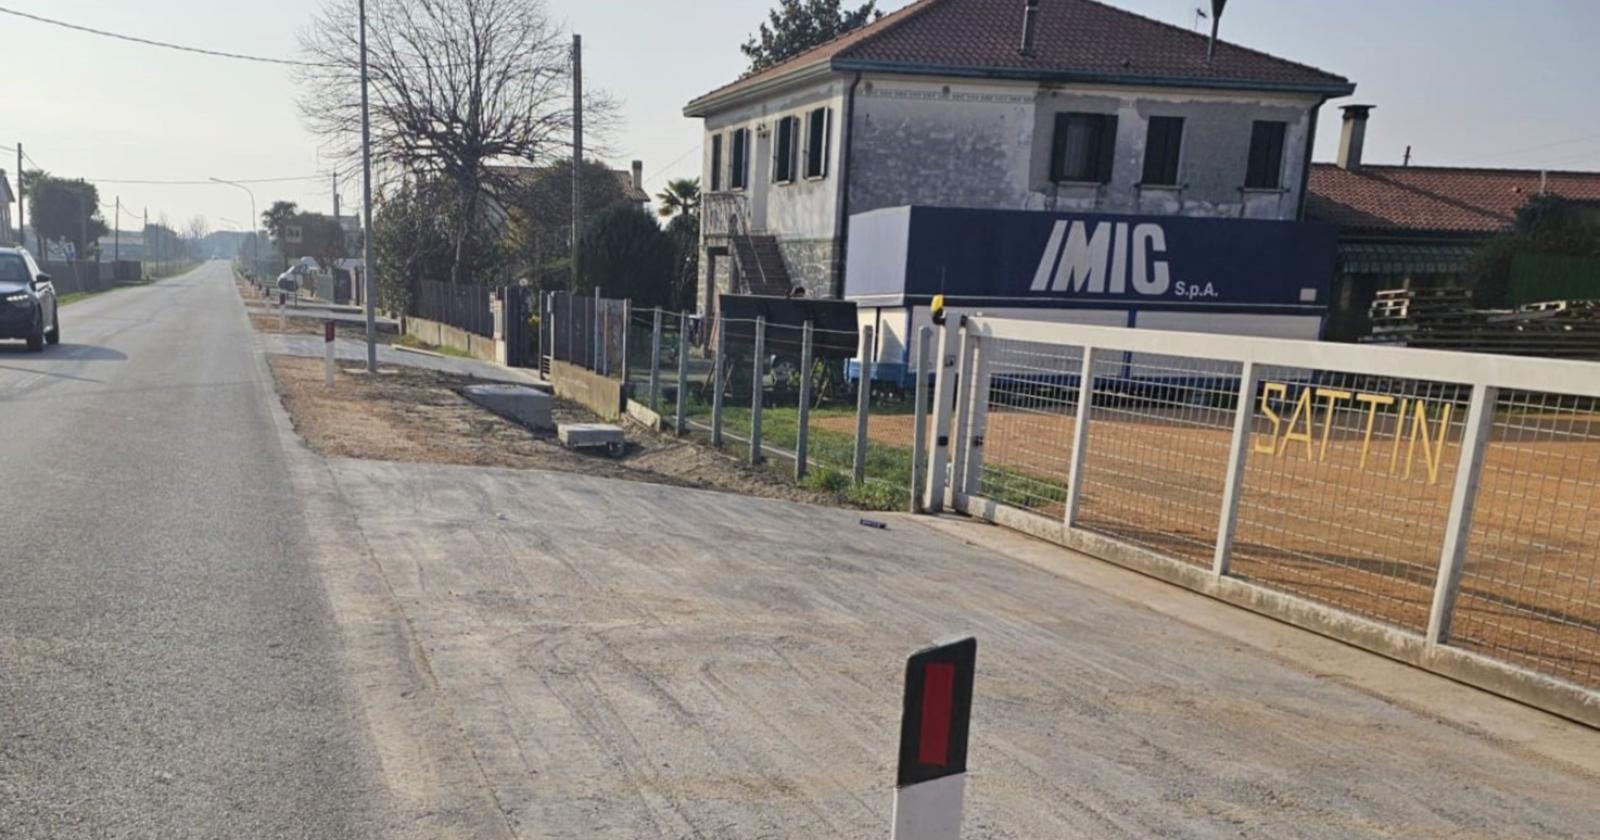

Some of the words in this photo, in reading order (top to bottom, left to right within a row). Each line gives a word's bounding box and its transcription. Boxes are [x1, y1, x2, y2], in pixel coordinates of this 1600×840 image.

[1030, 219, 1170, 295] IMIC
[1174, 280, 1218, 298] S.p.A.
[1254, 382, 1451, 485] SATTIN
